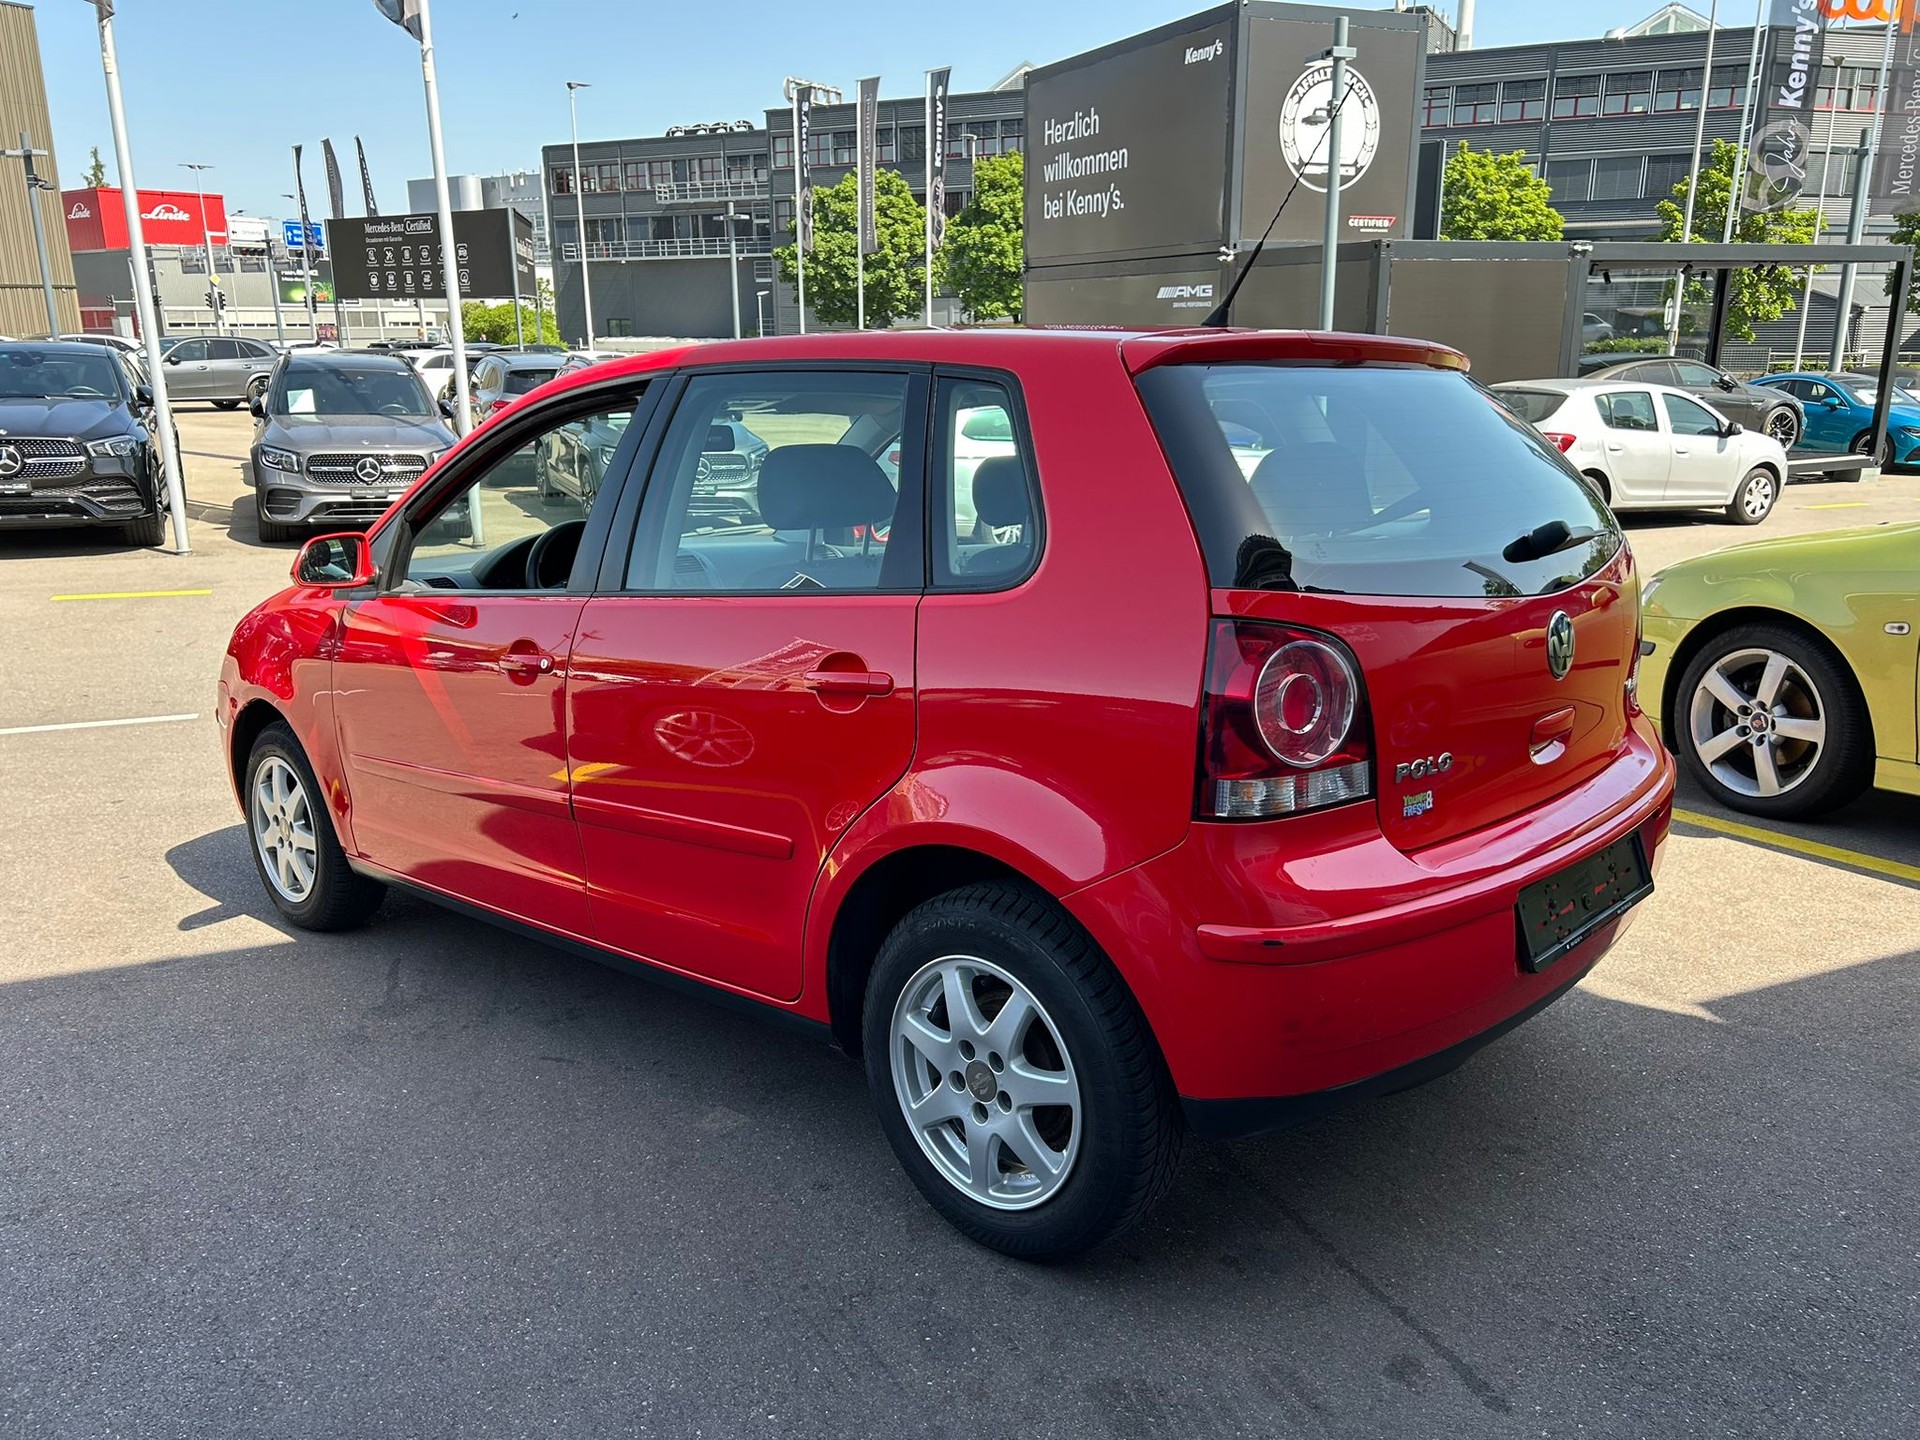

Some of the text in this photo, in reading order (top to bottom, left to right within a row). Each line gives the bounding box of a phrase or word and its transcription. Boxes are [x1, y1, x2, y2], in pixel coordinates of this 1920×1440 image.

[1184, 39, 1223, 65] Kenny's
[1297, 67, 1370, 102] AFFALTBACH
[1044, 107, 1100, 146] Herzlich
[1043, 148, 1128, 183] willkommen
[67, 202, 91, 219] Linde
[141, 203, 190, 221] Linde
[1043, 183, 1125, 220] bei Kenny's.
[364, 219, 431, 234] Mercedes-Benz Certified
[1348, 218, 1390, 228] CERTIFIED
[1174, 284, 1213, 298] AMG
[1395, 752, 1454, 784] POLO
